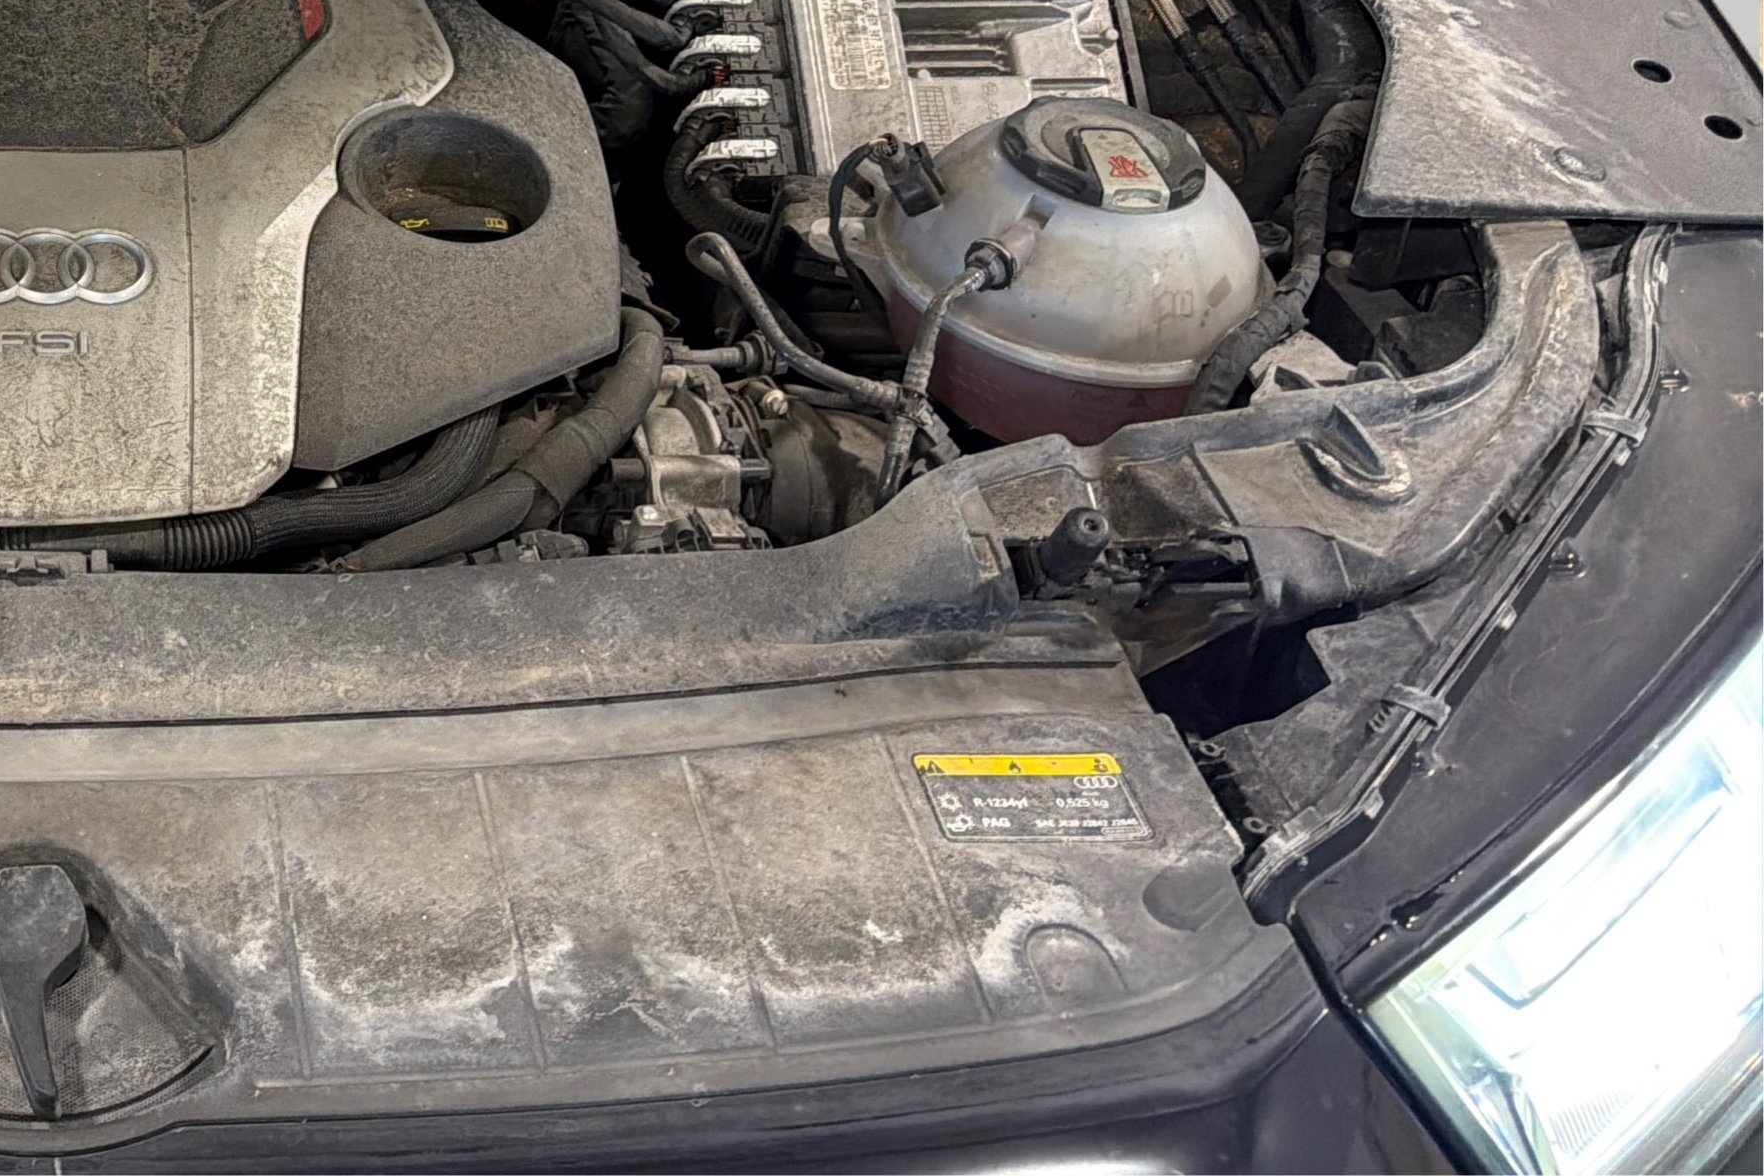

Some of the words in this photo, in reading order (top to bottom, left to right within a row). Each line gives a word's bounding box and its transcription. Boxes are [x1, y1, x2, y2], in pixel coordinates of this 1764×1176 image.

[973, 797, 1028, 809] R-1234yf
[1056, 798, 1090, 809] 0,525
[1091, 797, 1109, 809] kg
[982, 817, 1011, 827] PAG
